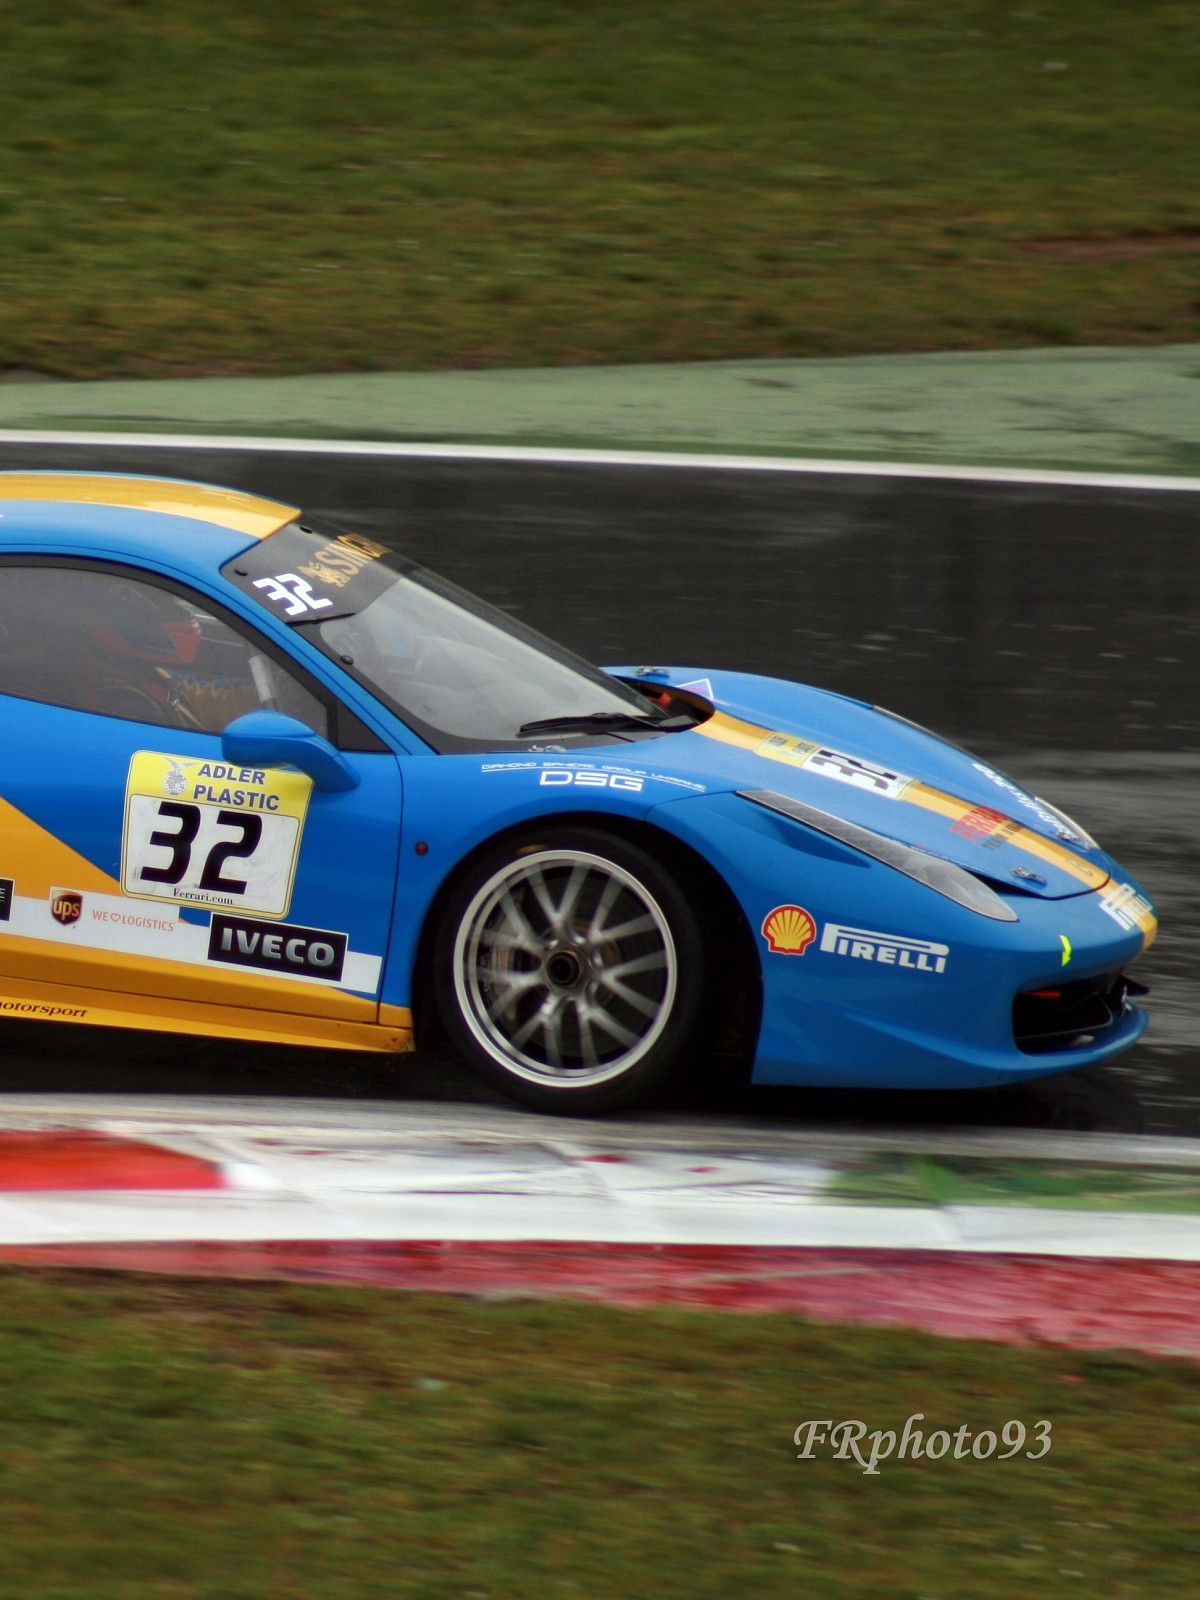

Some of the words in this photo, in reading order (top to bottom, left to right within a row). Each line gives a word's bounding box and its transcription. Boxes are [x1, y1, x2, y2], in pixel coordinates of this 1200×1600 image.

[252, 573, 334, 616] 32
[197, 763, 267, 786] ADLER
[539, 770, 644, 792] DSG
[192, 783, 281, 812] PLASTIC
[139, 800, 263, 896] 32
[52, 898, 82, 921] ups
[172, 887, 234, 906] Ferrari.com
[92, 909, 109, 923] WE
[121, 914, 175, 933] LOGISTICS
[220, 926, 335, 968] IVECO
[819, 922, 950, 974] PIRELLI
